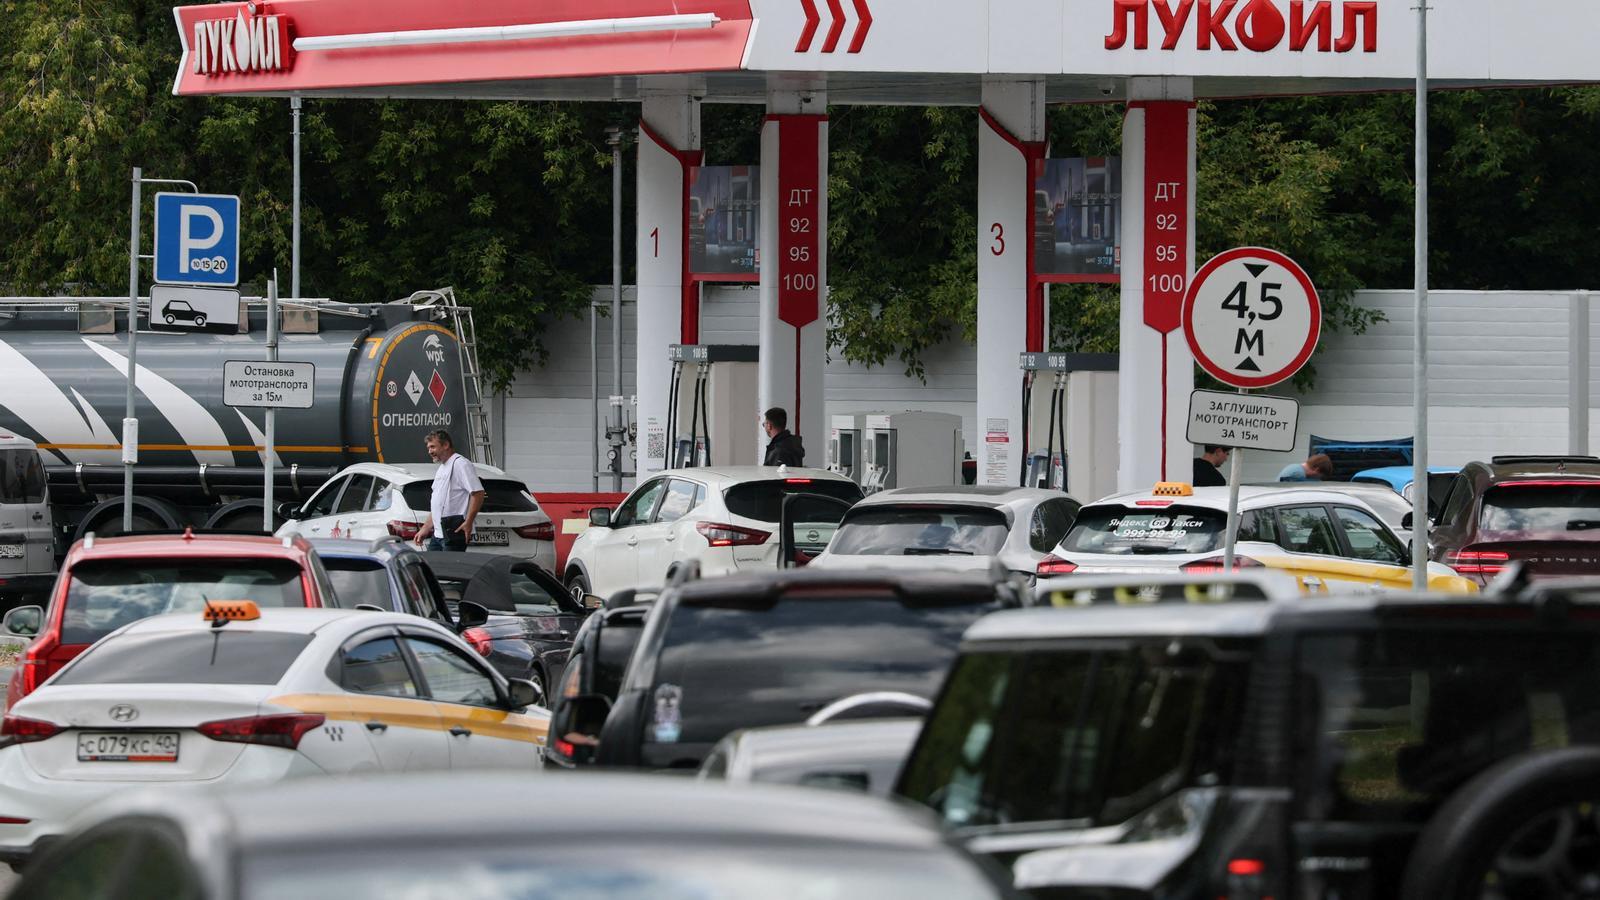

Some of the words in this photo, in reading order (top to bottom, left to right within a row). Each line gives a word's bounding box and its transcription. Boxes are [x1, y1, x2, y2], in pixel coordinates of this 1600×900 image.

[788, 189, 812, 207] ДТ
[1154, 182, 1180, 202] ДТ
[790, 218, 810, 232] 92
[1156, 214, 1177, 230] 92
[179, 204, 224, 274] P
[650, 227, 658, 258] 1
[990, 222, 1005, 256] 3
[789, 246, 810, 261] 95
[1155, 245, 1177, 262] 95
[193, 260, 200, 268] 10
[202, 260, 210, 269] 15
[213, 260, 226, 270] 20
[783, 274, 816, 291] 100
[1149, 274, 1183, 292] 100
[1221, 281, 1283, 326] 4,5
[426, 350, 444, 366] wpt
[1028, 355, 1035, 367] 92
[1048, 355, 1057, 368] 100
[1059, 355, 1066, 368] 95
[244, 365, 295, 377] Остановка
[229, 380, 308, 392] мототранспорта
[252, 393, 263, 401] за
[265, 391, 283, 402] 15м
[1209, 401, 1277, 416] ЗАГЛУШИТЬ
[382, 412, 452, 427] ОГНЕОПАСНО
[1195, 414, 1289, 431] МОТОТРАНСПОРТ
[1221, 428, 1235, 439] ЗА
[1108, 518, 1148, 527] Яндекс
[1171, 518, 1203, 528] Такси
[1122, 529, 1187, 538] 999-99-99
